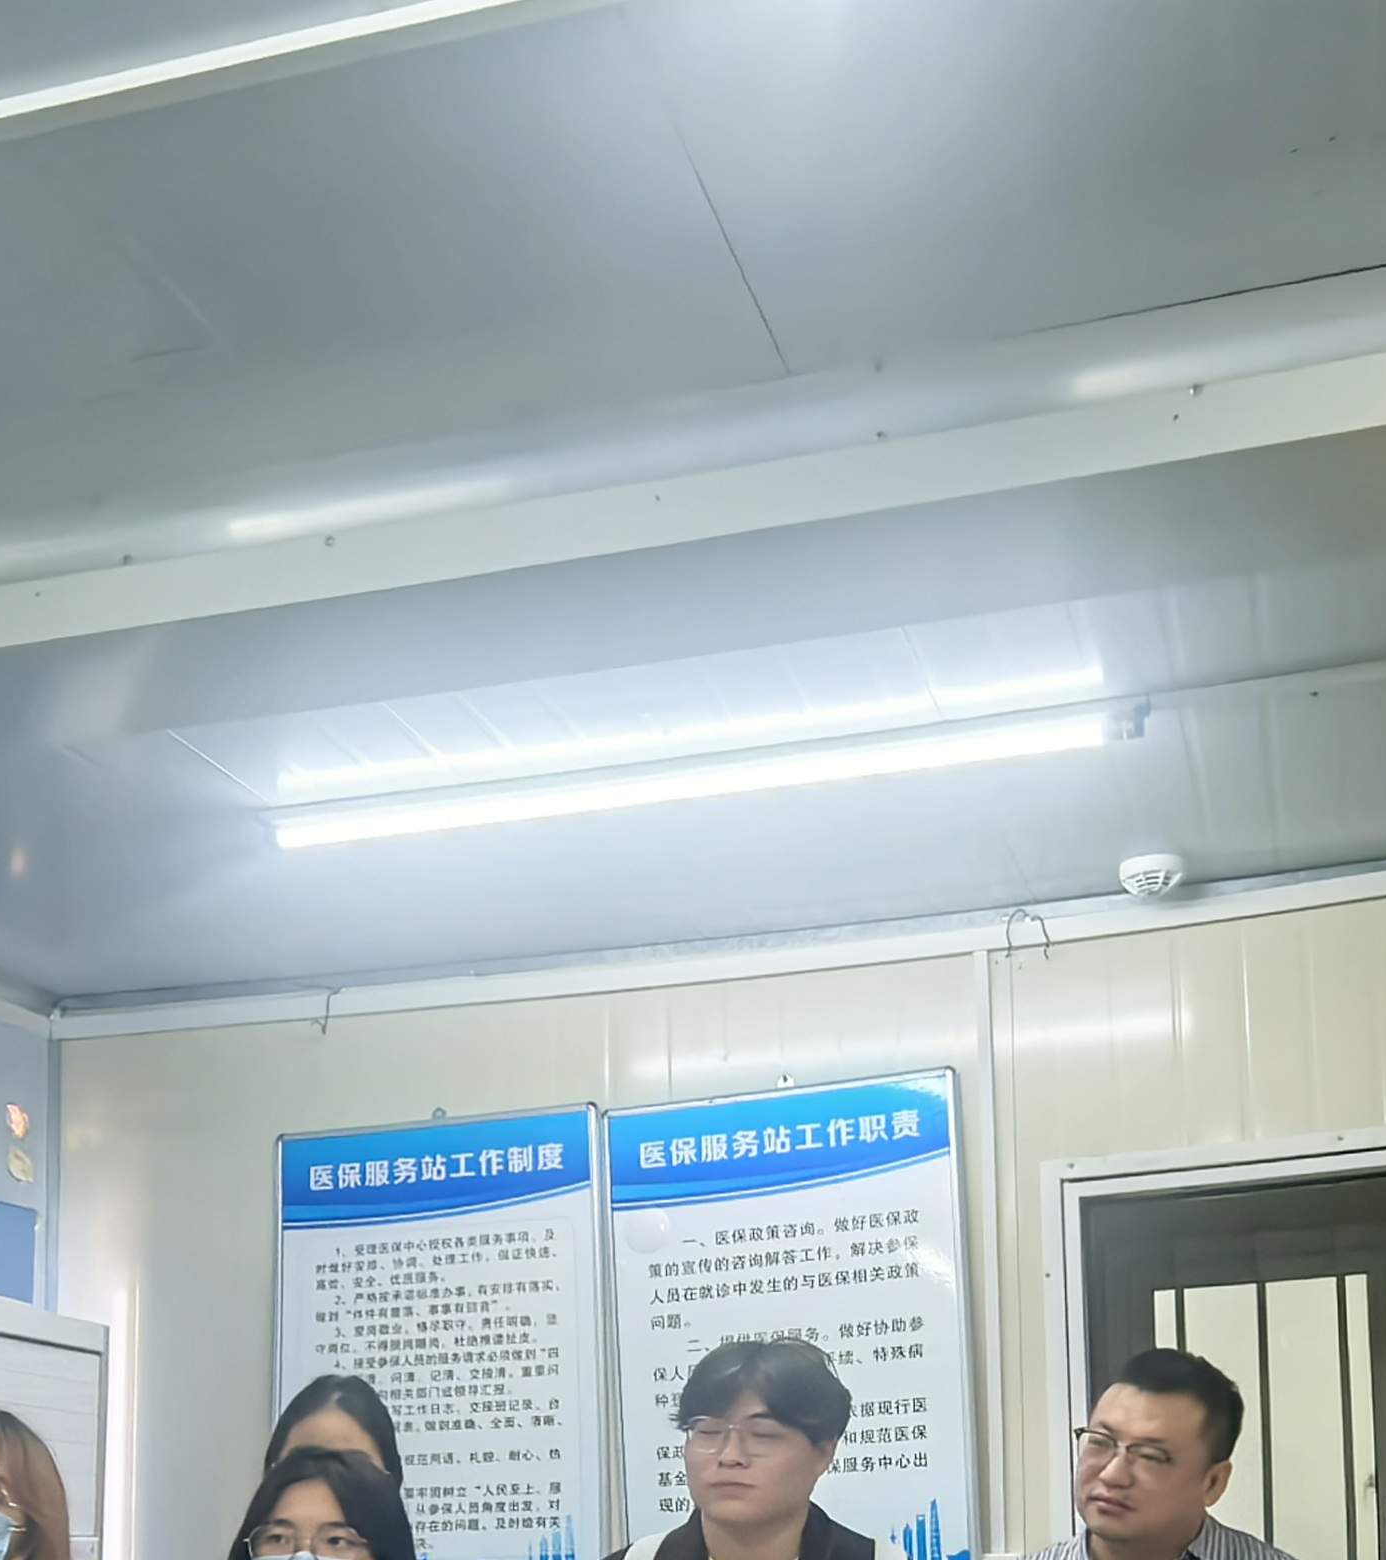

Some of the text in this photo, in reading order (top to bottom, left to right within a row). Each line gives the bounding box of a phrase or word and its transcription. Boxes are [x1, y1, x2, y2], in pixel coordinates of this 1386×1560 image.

[639, 1109, 921, 1169] 医保服务站工作职责
[309, 1143, 565, 1191] 医保服务站工作制度
[682, 1208, 919, 1248] 一、医保政策咨询。做好医保政
[649, 1262, 920, 1305] 人员在就诊中发生的与医保相关政策
[650, 1313, 692, 1331] 问题。
[842, 1424, 927, 1446] 和规范医保
[659, 1497, 691, 1513] 现的
